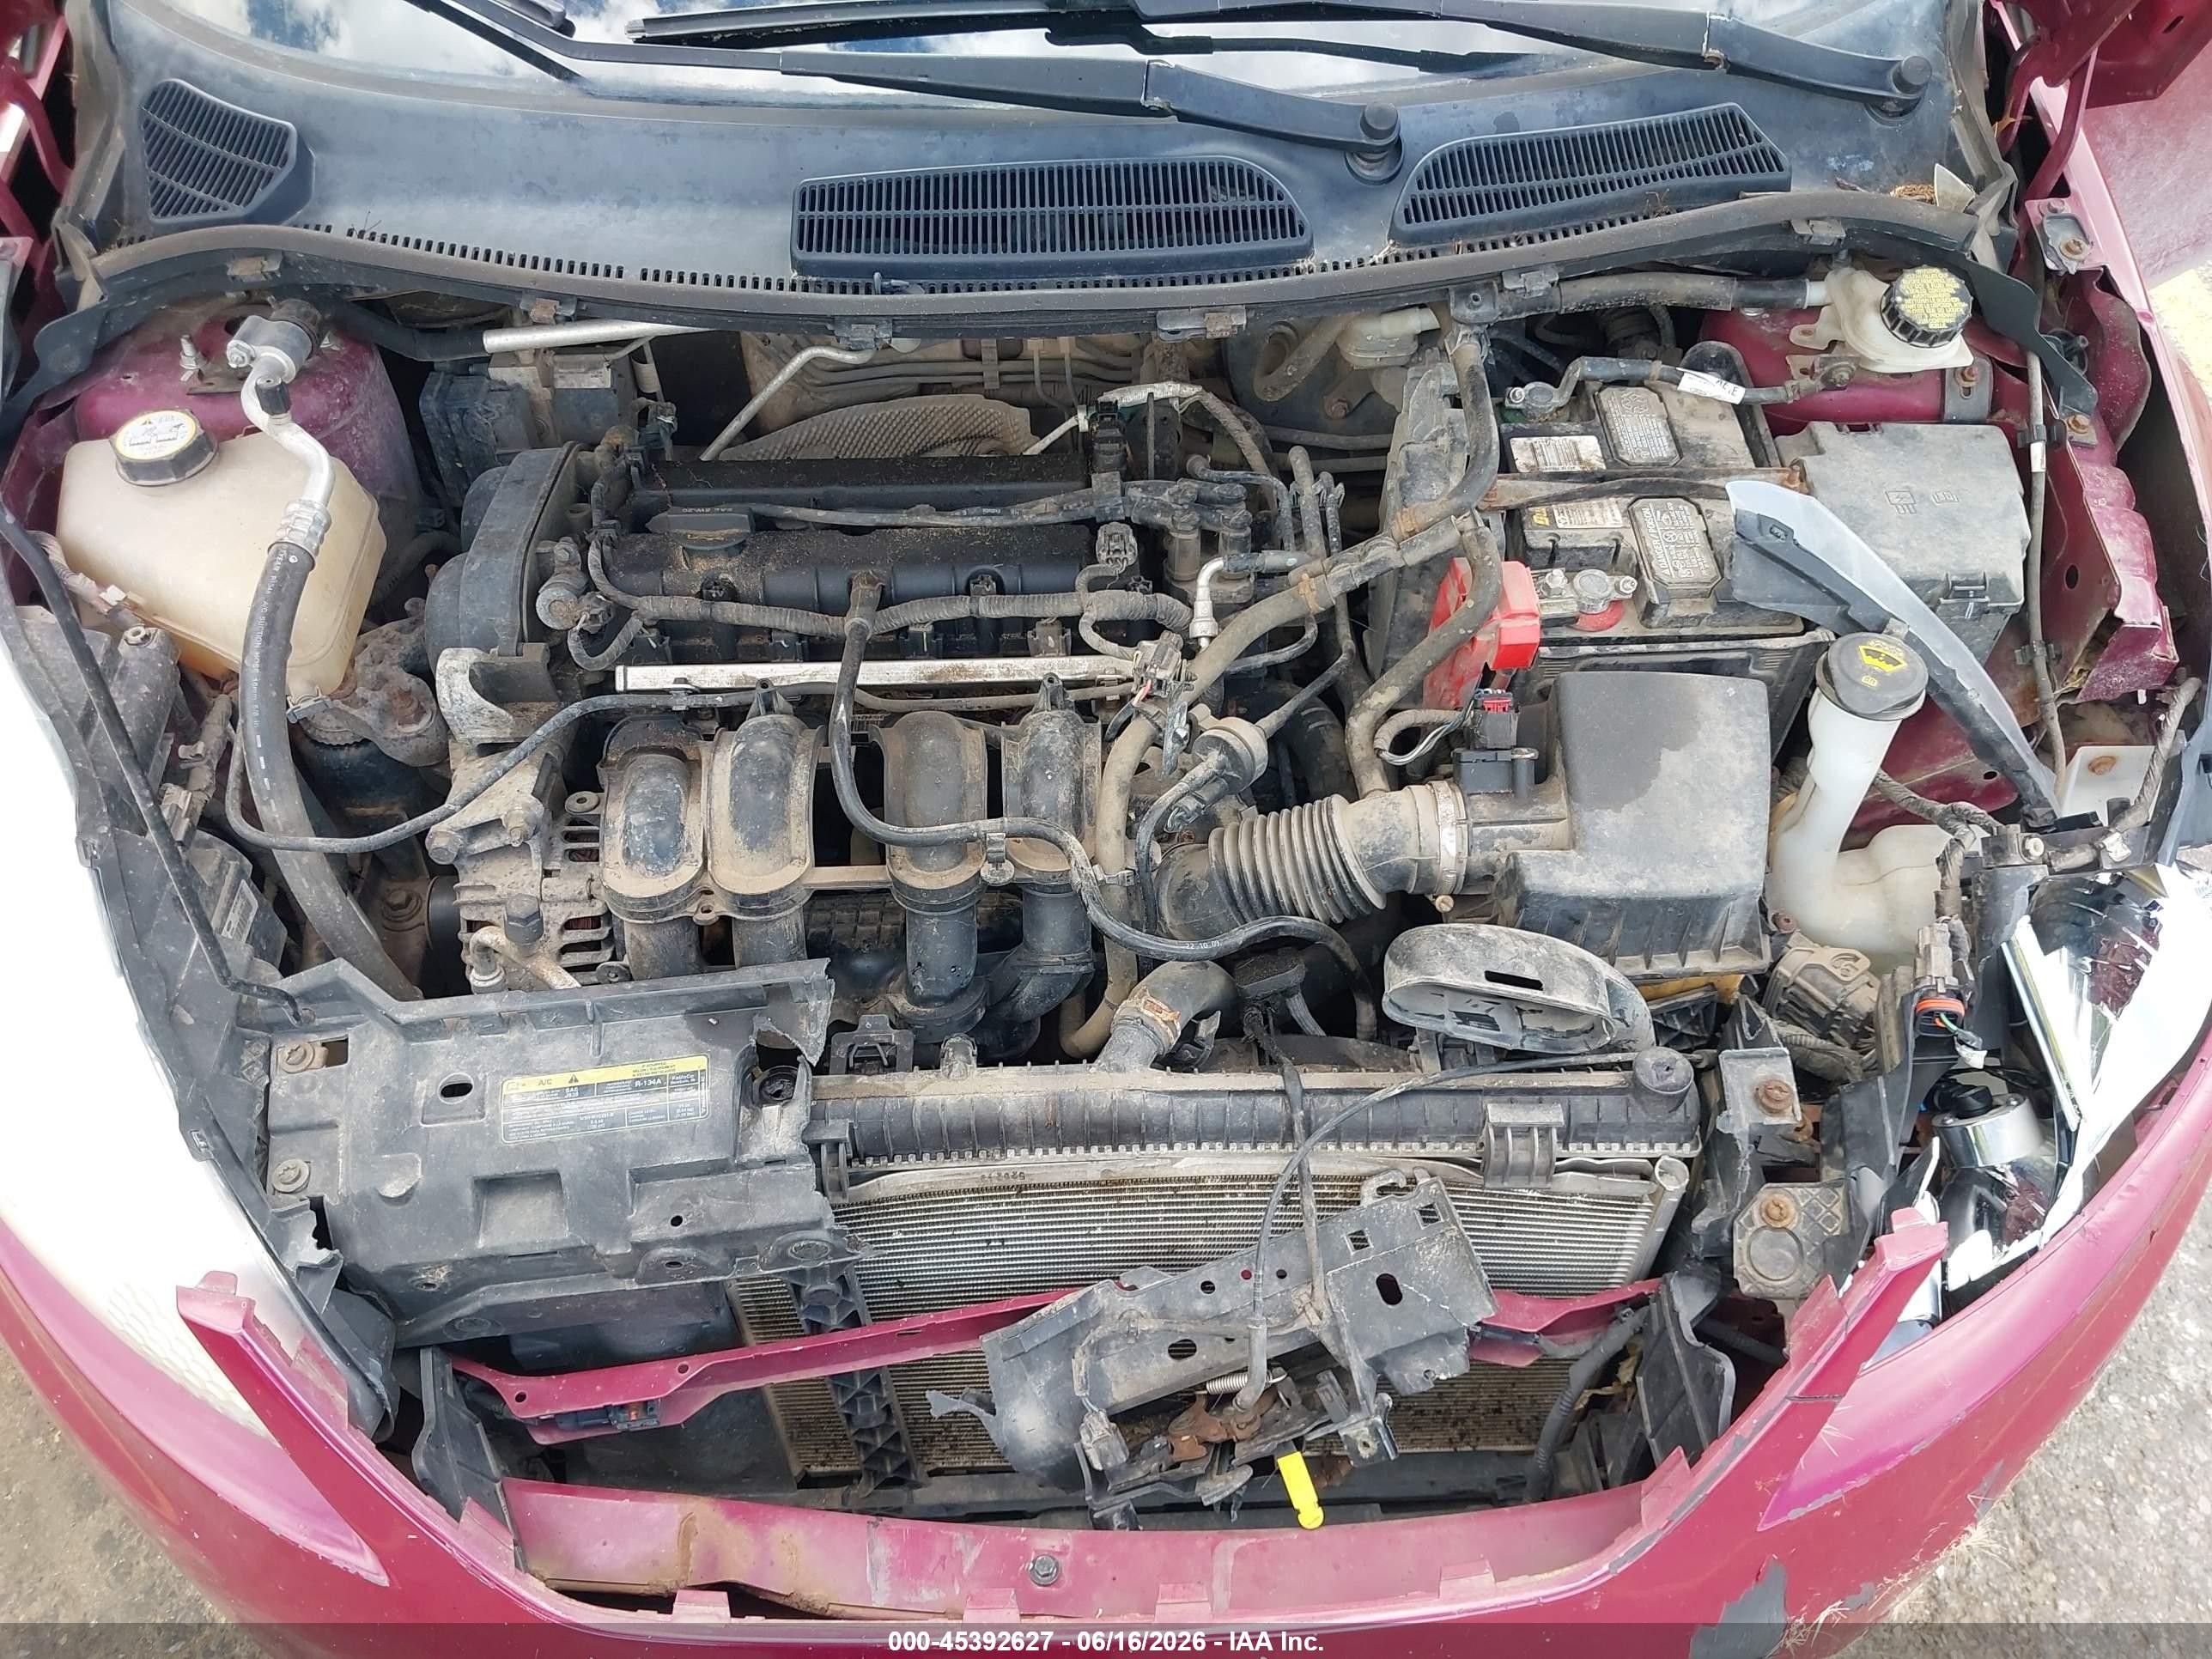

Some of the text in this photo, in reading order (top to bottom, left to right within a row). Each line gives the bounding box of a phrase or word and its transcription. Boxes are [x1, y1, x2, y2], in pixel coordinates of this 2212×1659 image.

[1652, 539, 1668, 568] DANGER
[259, 600, 270, 613] A/C
[253, 616, 265, 648] SUCTION
[252, 652, 261, 673] HOSE
[635, 1079, 661, 1087] R-134A
